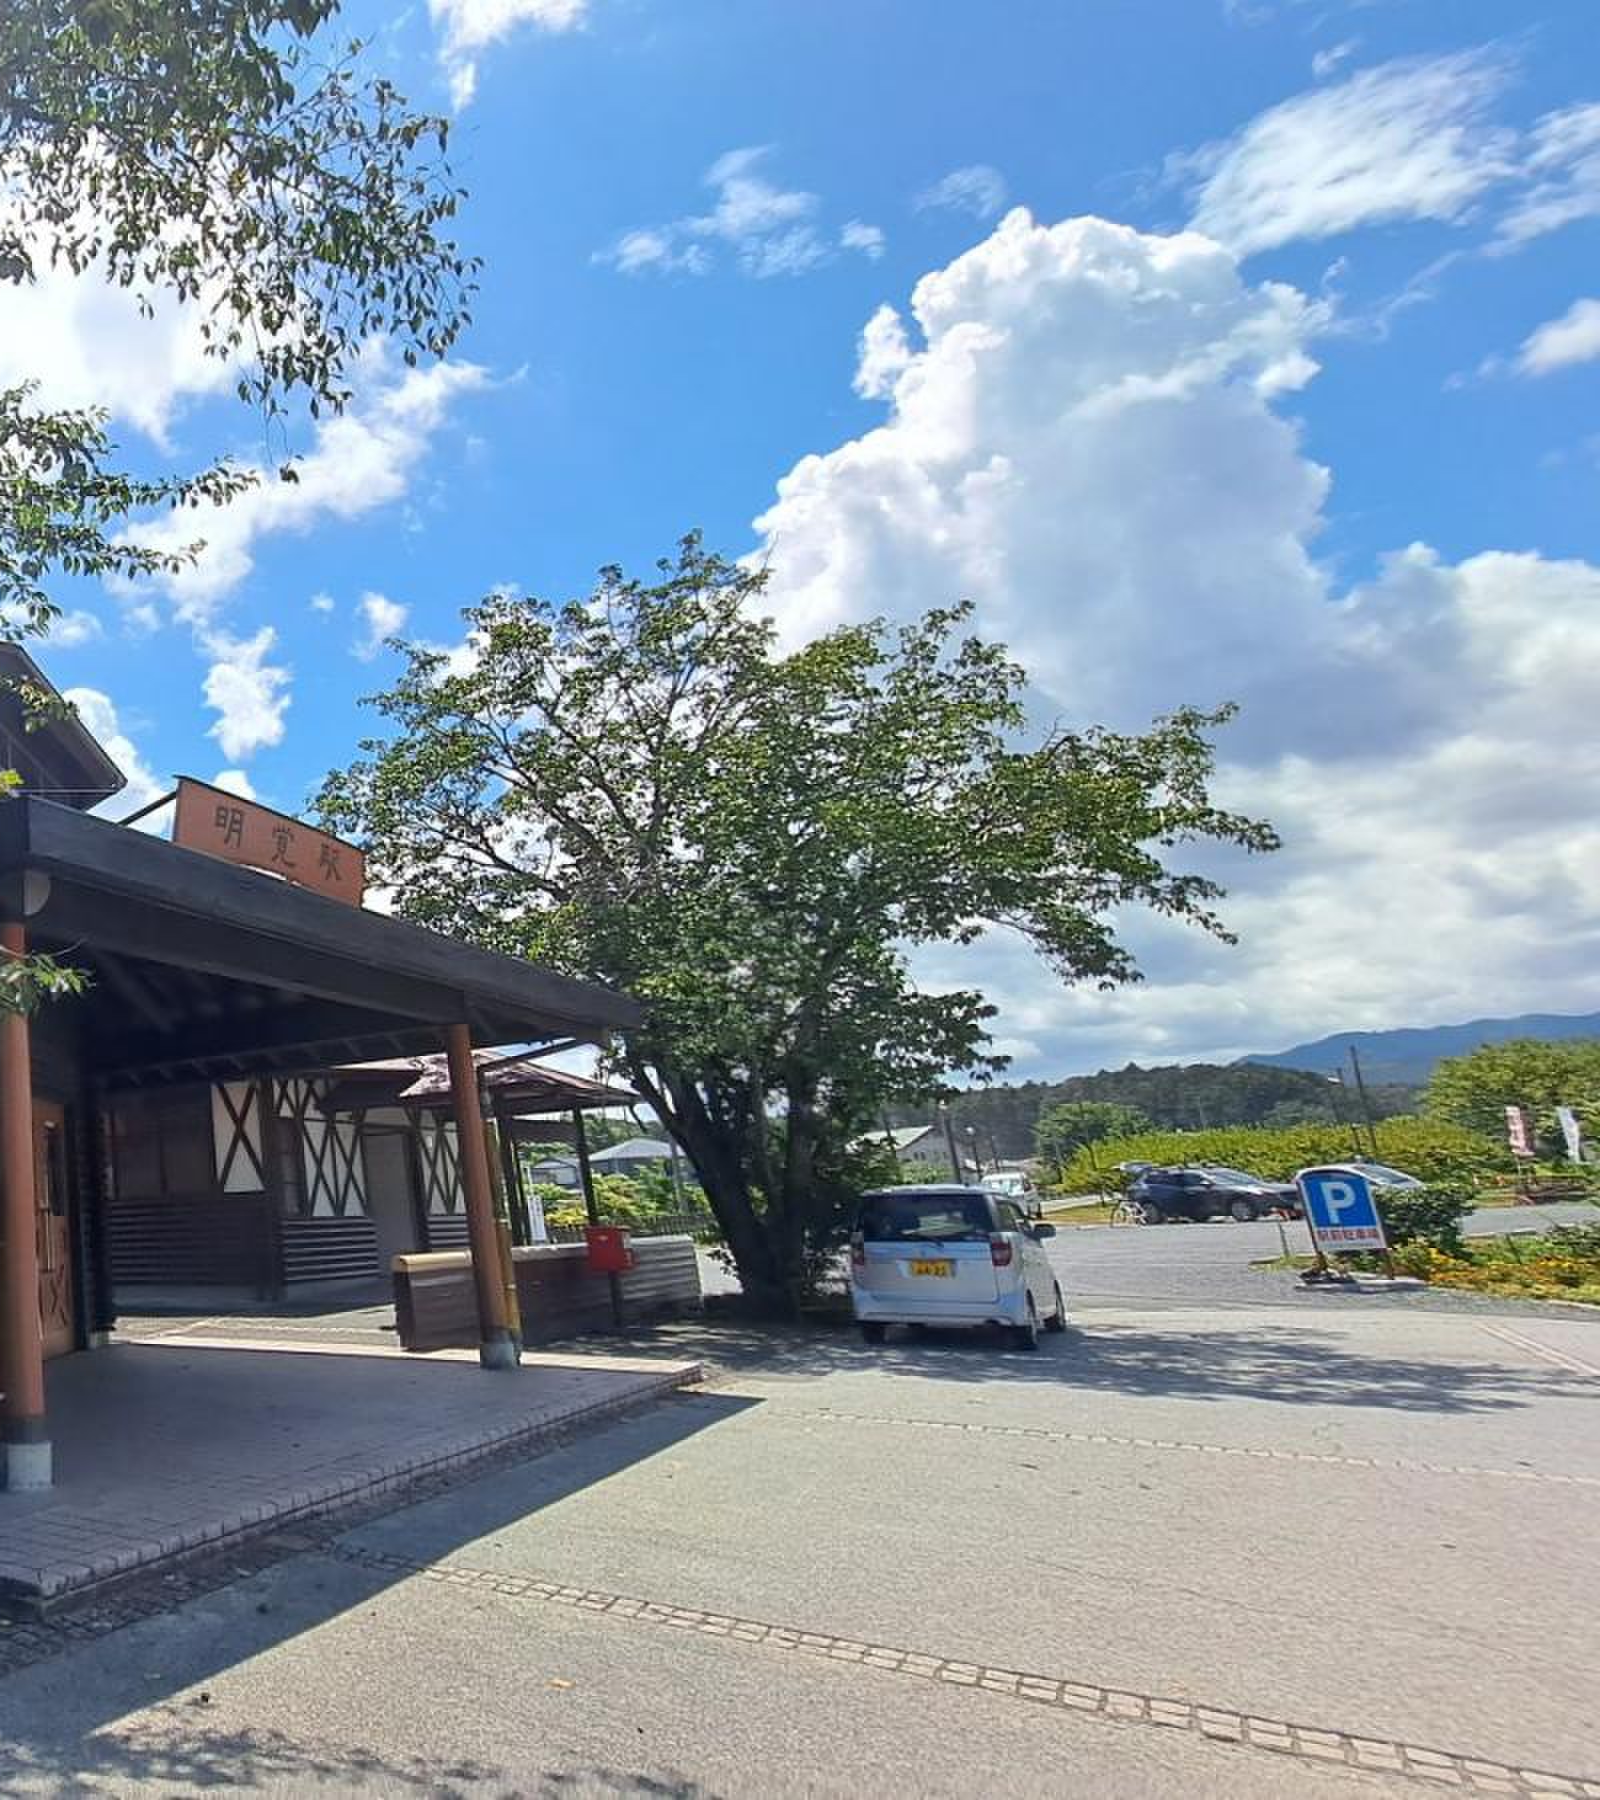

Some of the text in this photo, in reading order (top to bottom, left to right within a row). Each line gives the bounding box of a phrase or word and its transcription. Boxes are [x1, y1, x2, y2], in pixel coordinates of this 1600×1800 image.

[215, 806, 342, 881] 明覚駅
[1320, 1181, 1357, 1225] P
